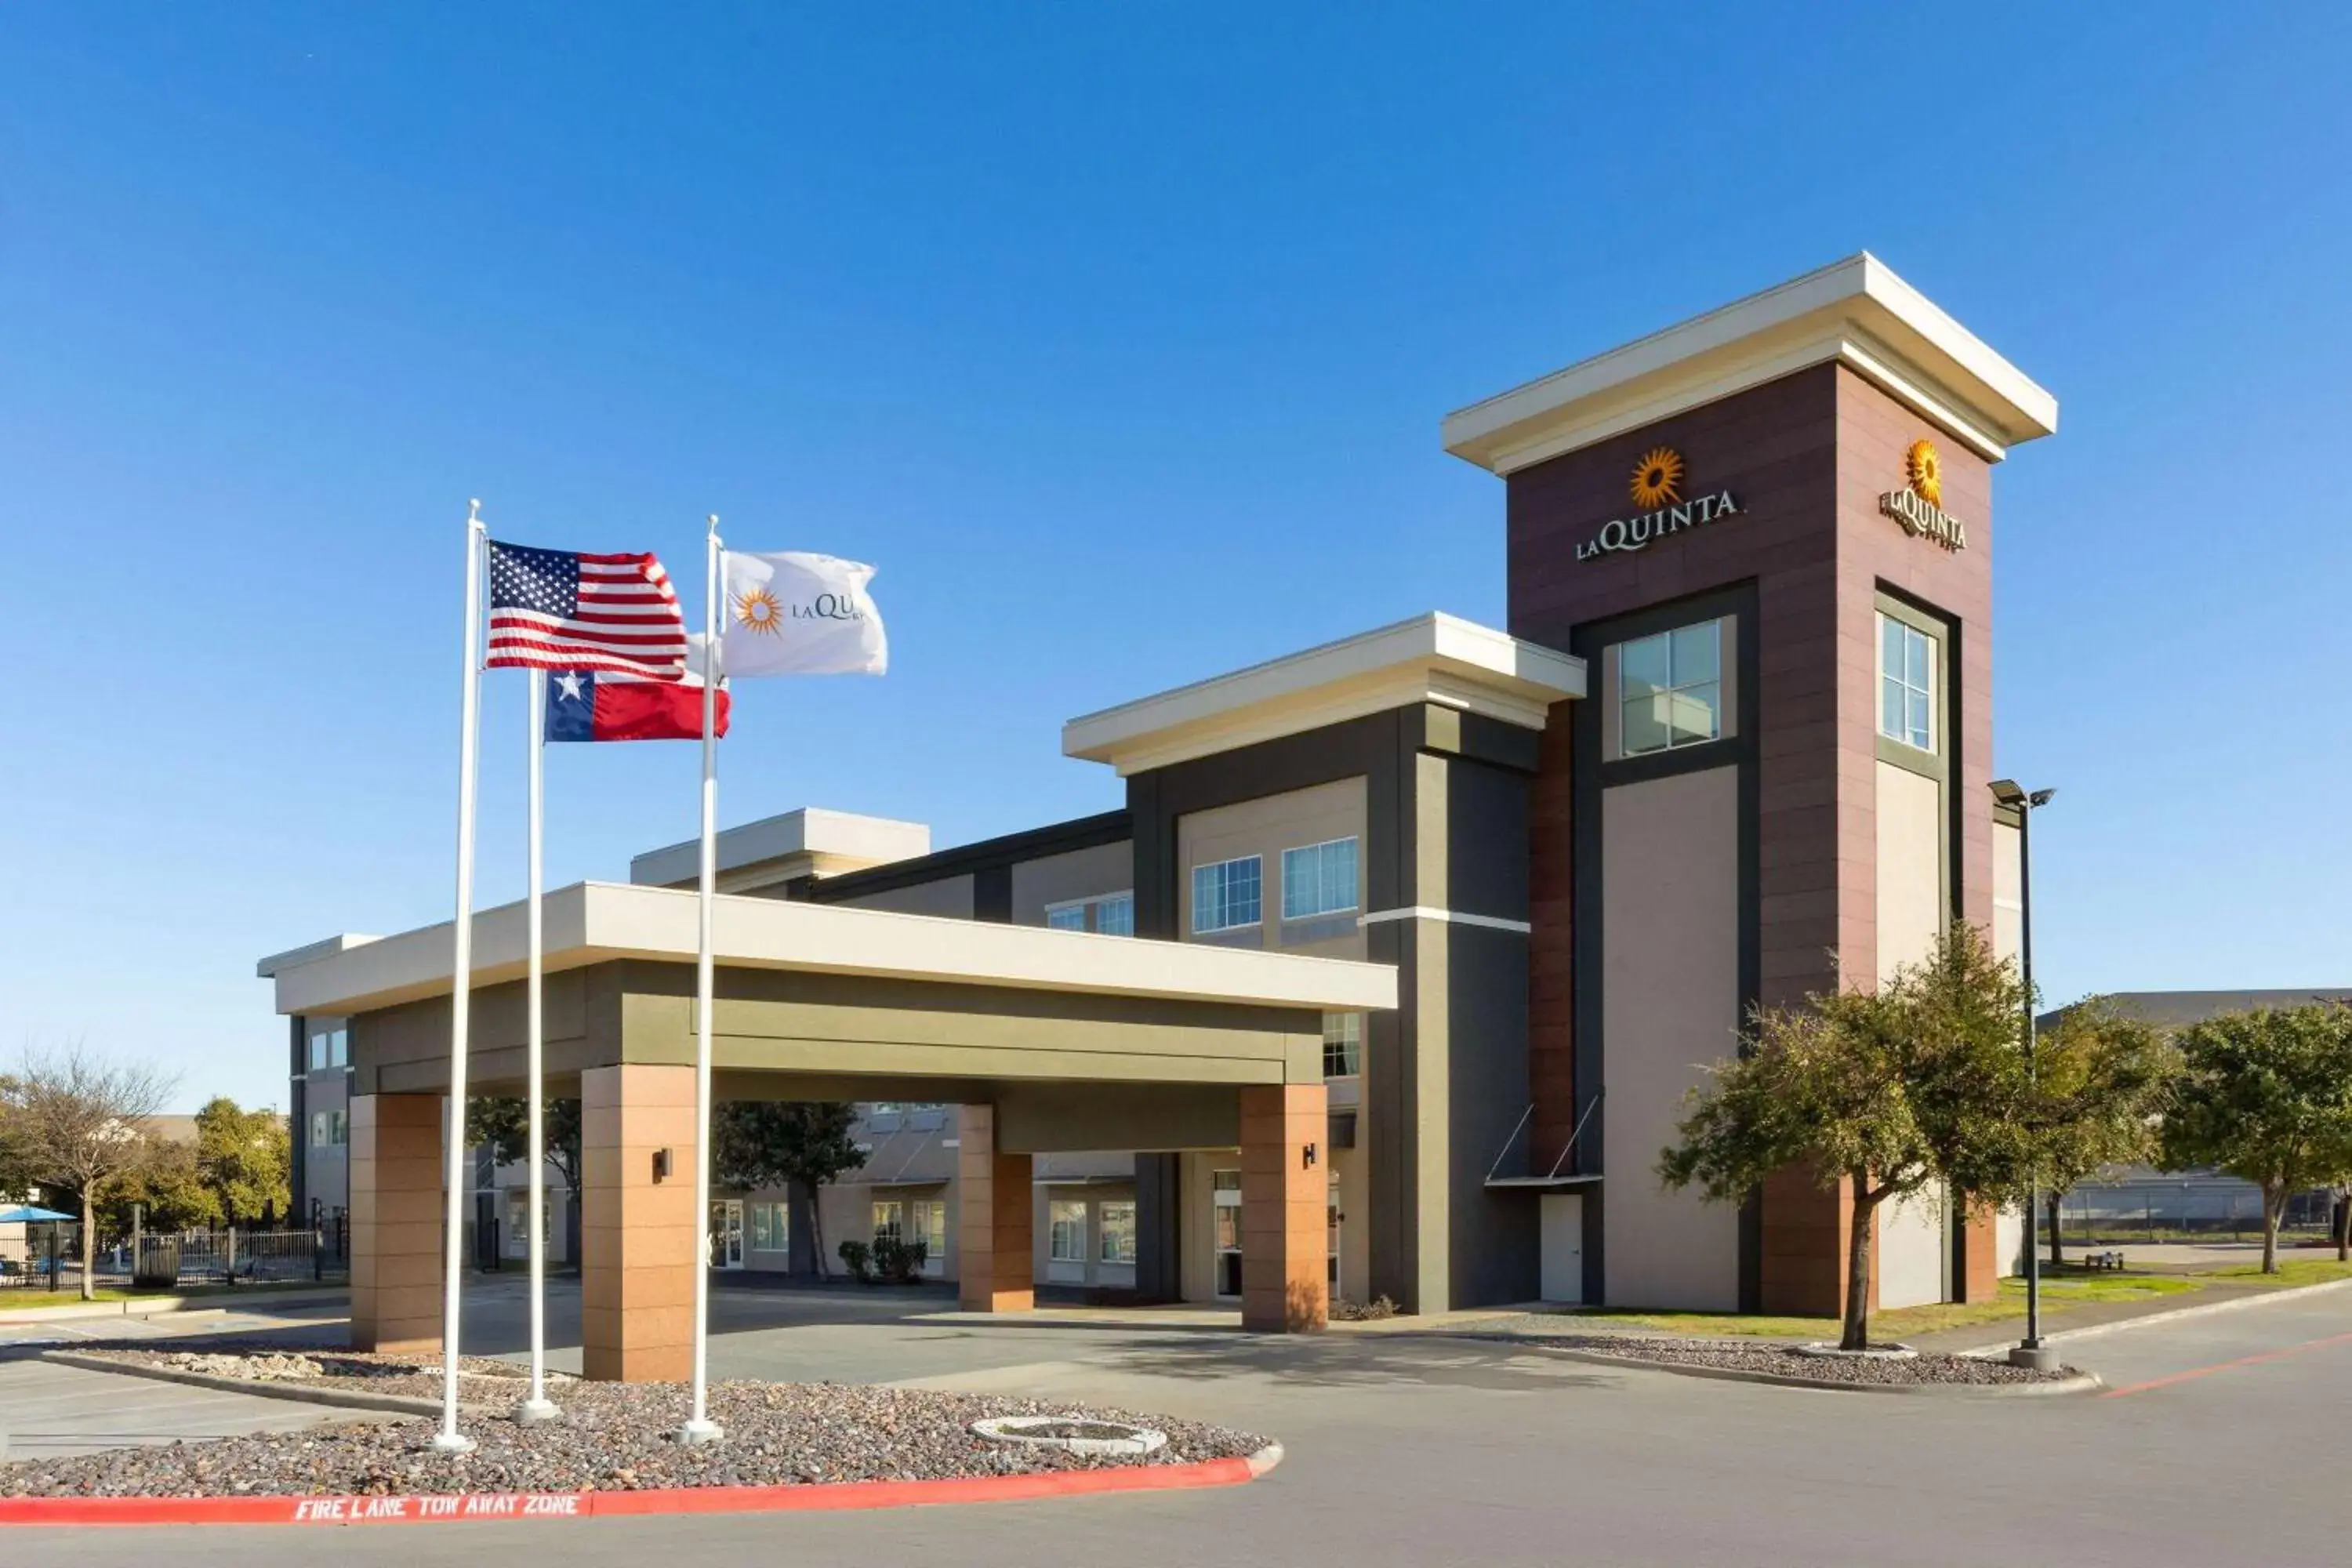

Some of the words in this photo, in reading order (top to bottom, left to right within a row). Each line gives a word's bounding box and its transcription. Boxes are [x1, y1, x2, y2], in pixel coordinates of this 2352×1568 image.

[296, 1498, 346, 1520] FIRE
[350, 1497, 407, 1518] LANE
[419, 1496, 459, 1516] TOW
[465, 1495, 519, 1515] AWAY
[524, 1494, 582, 1515] ZONE
